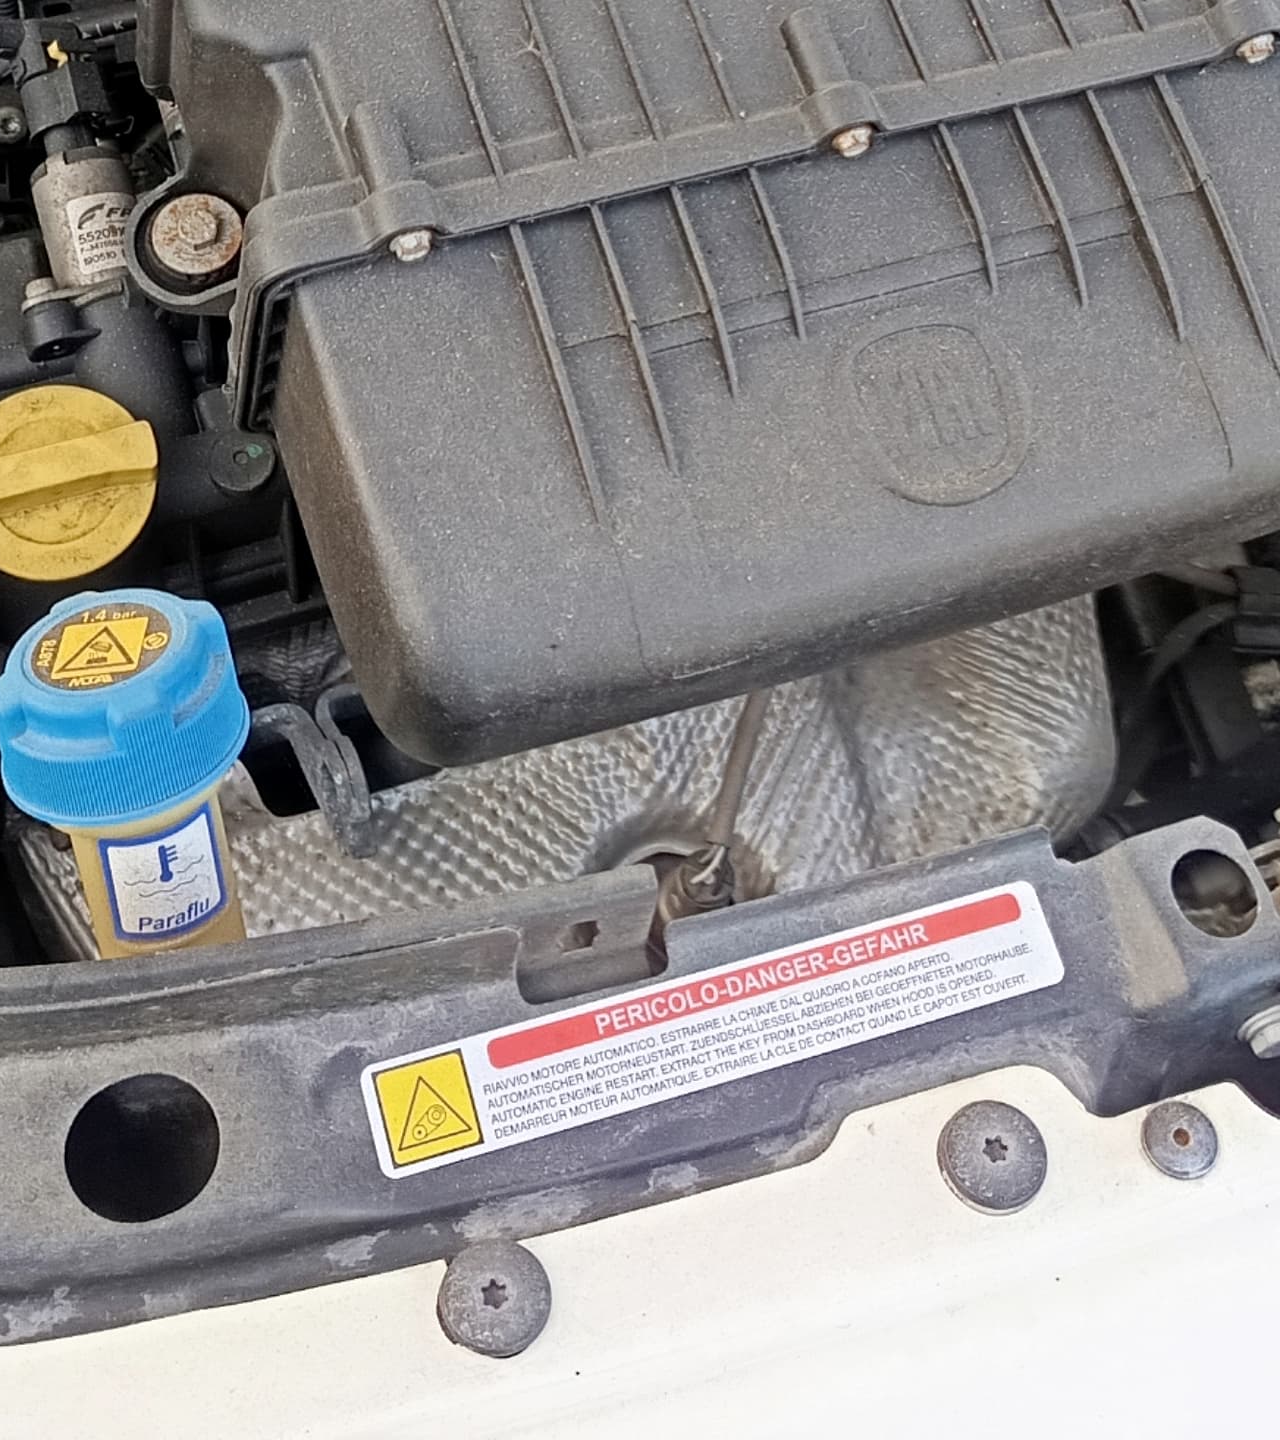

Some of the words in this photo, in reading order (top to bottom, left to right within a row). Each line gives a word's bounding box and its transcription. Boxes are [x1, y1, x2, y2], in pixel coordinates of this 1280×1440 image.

[82, 609, 107, 623] 1.4
[112, 609, 137, 620] bar
[138, 897, 209, 931] Paraflu
[594, 921, 929, 1035] PERICOLO-DANGER-GEFAHR
[482, 1072, 530, 1095] RIAVVIO
[530, 1058, 581, 1081] MOTORE
[581, 1035, 659, 1067] AUTOMATICO.
[660, 1017, 722, 1044] ESTRARRE
[721, 1012, 738, 1026] LA
[737, 1000, 778, 1021] CHIAVE
[779, 993, 802, 1009] DAL
[801, 979, 851, 1003] QUADRO
[851, 977, 861, 988] A
[859, 963, 907, 986] COFANO
[906, 950, 952, 973] APERTO.
[486, 1072, 585, 1110] AUTOMATISCHER
[584, 1042, 688, 1081] MOTORNEUSTART.
[799, 994, 854, 1019] ABZIEHEN
[854, 988, 873, 1002] BEI
[874, 964, 955, 997] GEOEFFNETER
[954, 942, 1032, 973] MOTORHAUBE.
[489, 1096, 558, 1125] AUTOMATIC
[558, 1082, 603, 1105] ENGINE
[604, 1066, 659, 1091] RESTART.
[659, 1050, 712, 1075] EXTRACT
[713, 1043, 738, 1059] THE
[737, 1036, 762, 1052] KEY
[762, 1026, 796, 1045] FROM
[796, 1006, 866, 1035] DASHBOARD
[865, 995, 901, 1015] WHEN
[900, 986, 935, 1005] HOOD
[935, 982, 948, 995] IS
[947, 968, 996, 991] OPENED.
[493, 1108, 568, 1139] DEMARREUR
[568, 1093, 618, 1117] MOTEUR
[703, 1052, 759, 1078] EXTRAIRE
[759, 1047, 776, 1061] LA
[774, 1041, 797, 1057] CLE
[797, 1036, 815, 1050] DE
[815, 1020, 867, 1045] CONTACT
[867, 1009, 906, 1029] QUAND
[907, 1004, 923, 1018] LE
[923, 993, 960, 1013] CAPOT
[960, 987, 982, 1002] EST
[982, 973, 1029, 995] OUVERT.
